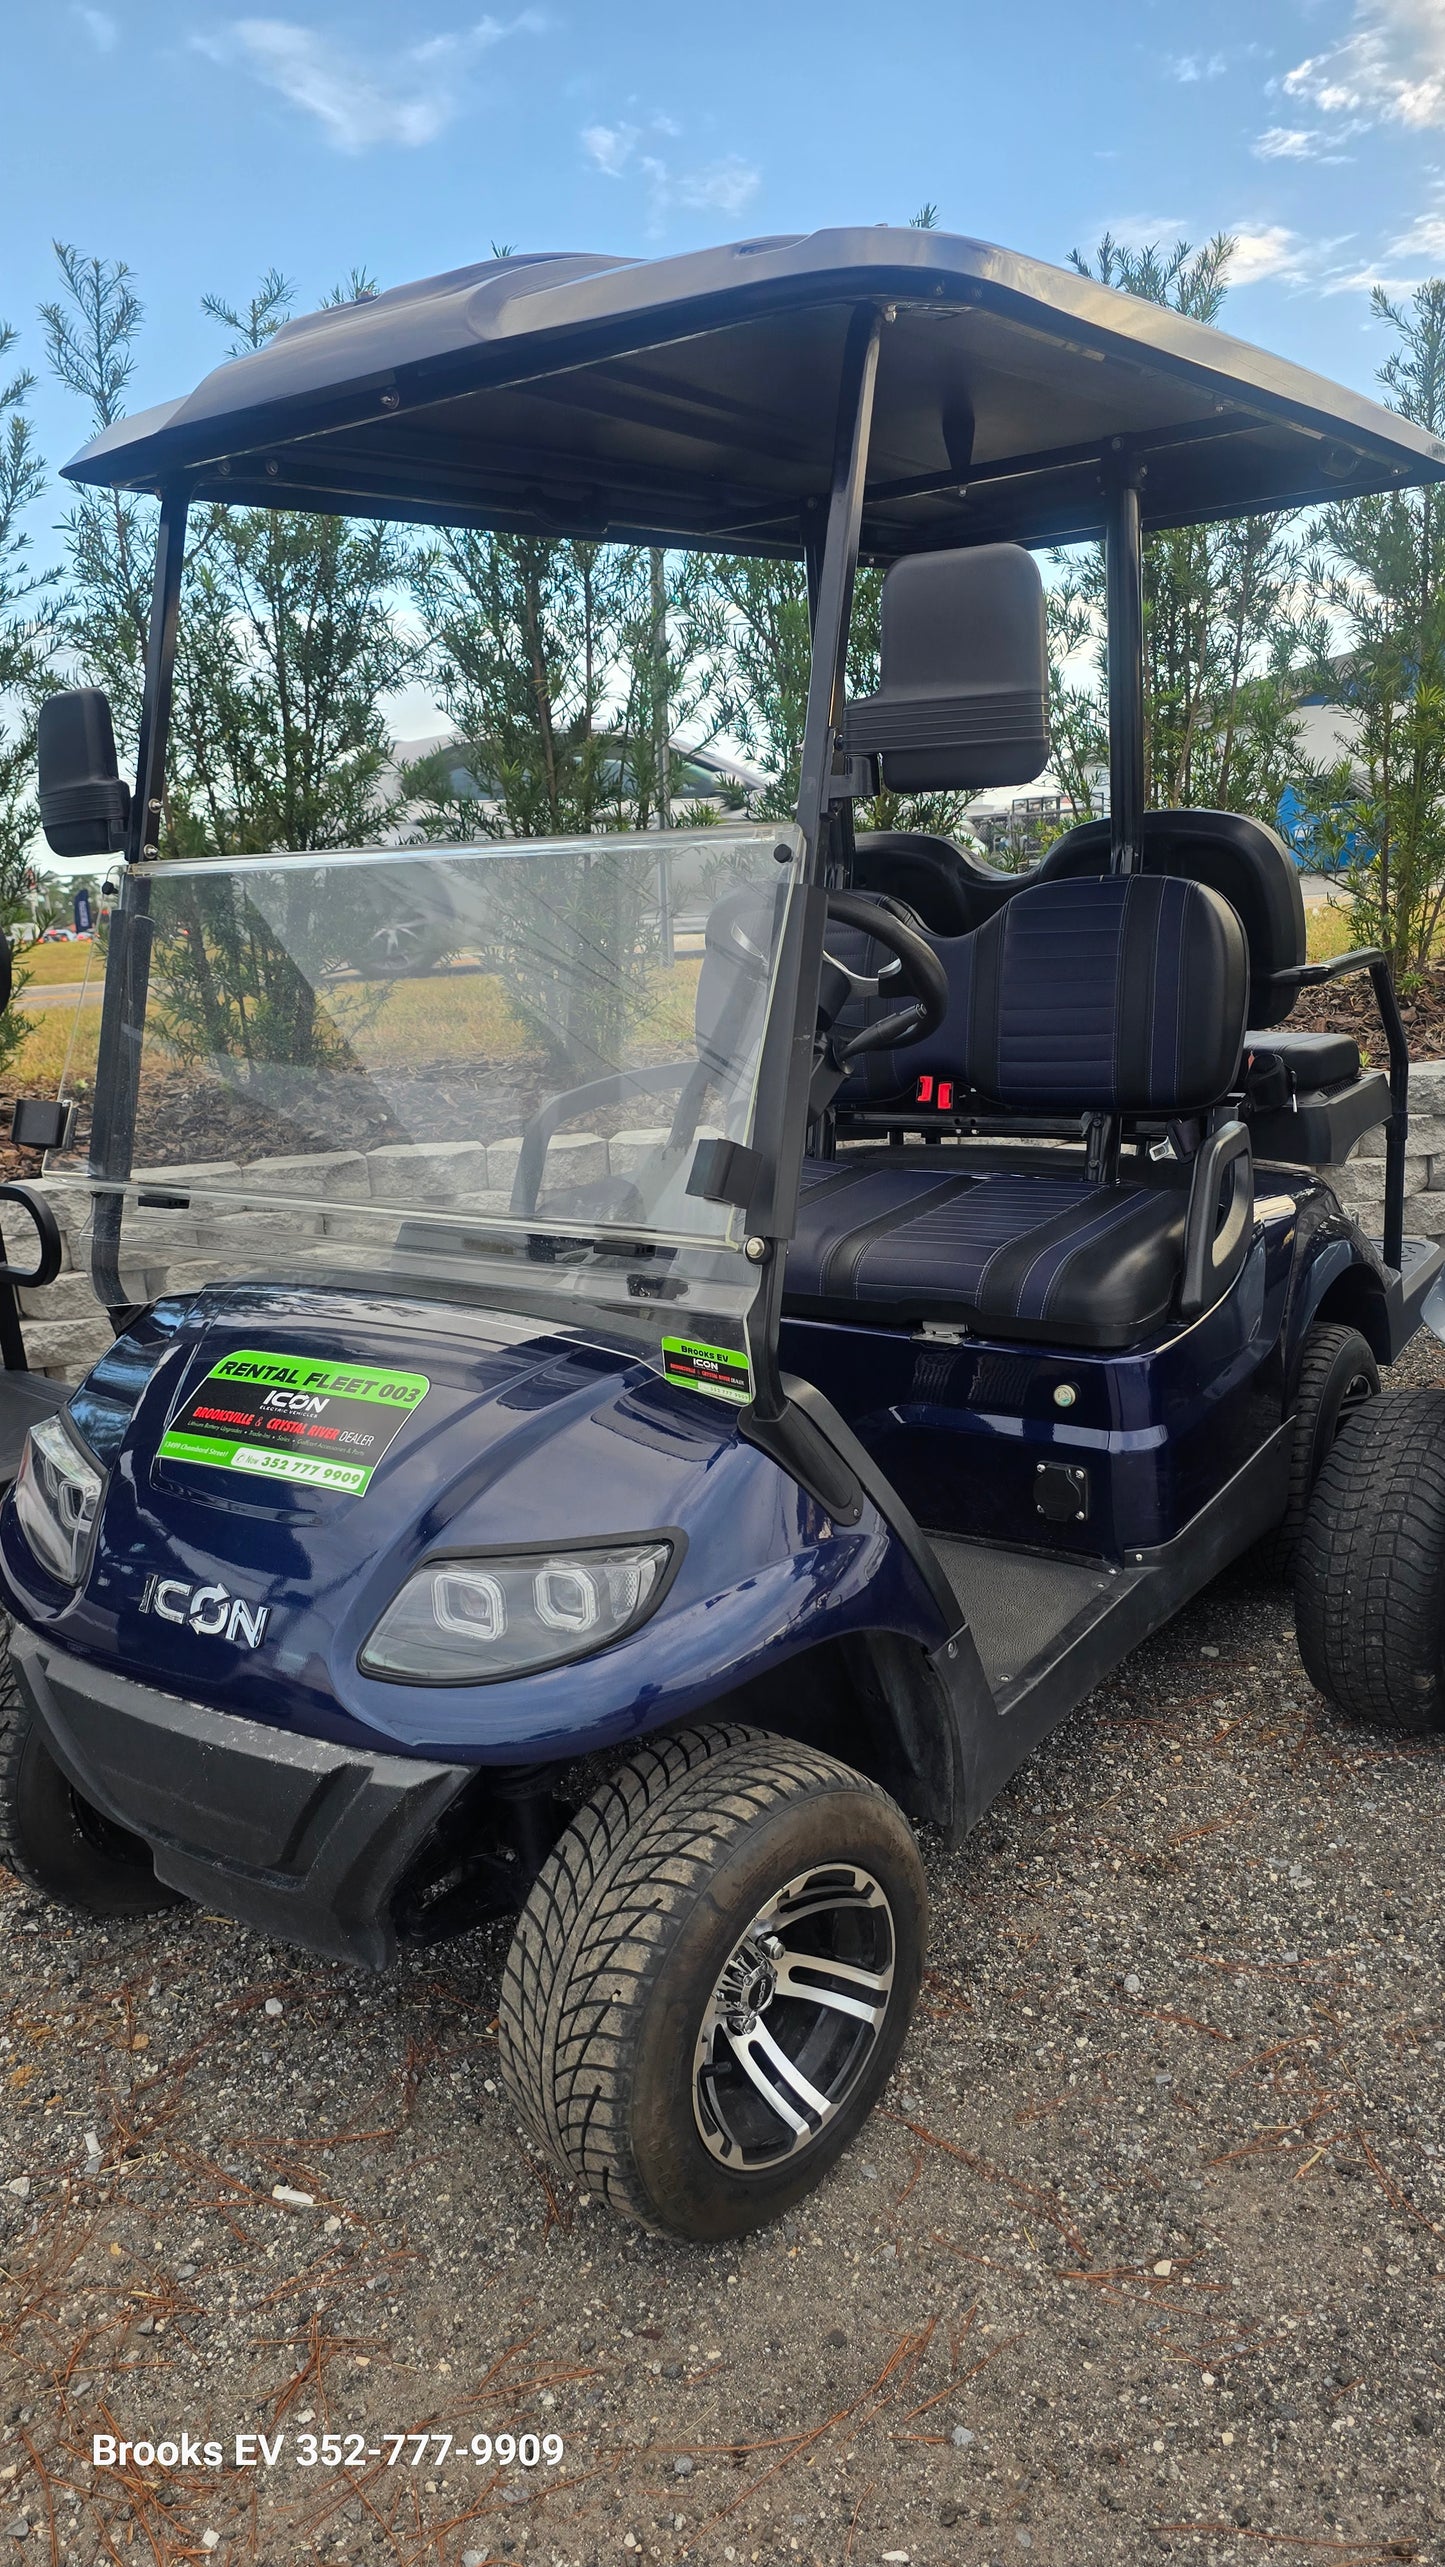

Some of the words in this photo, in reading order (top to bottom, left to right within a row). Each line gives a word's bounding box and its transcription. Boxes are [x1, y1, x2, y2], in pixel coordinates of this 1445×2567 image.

[681, 1345, 715, 1360] BROOKS
[717, 1353, 729, 1363] EV
[693, 1358, 719, 1371] ICON
[218, 1361, 300, 1385] RENTAL
[303, 1372, 379, 1395] FLEET
[378, 1383, 422, 1403] 003
[259, 1405, 288, 1414] ELECTRIC
[289, 1410, 318, 1419] VEHICLES
[263, 1390, 331, 1413] ICON
[192, 1406, 256, 1426] BROOKSVILLE
[254, 1416, 264, 1428] &
[266, 1417, 308, 1436] CRYSTAL
[307, 1424, 341, 1441] RIVER
[339, 1430, 375, 1447] DEALER
[261, 1456, 290, 1470] 352
[291, 1462, 321, 1475] 777
[323, 1468, 361, 1484] 9909
[138, 1572, 271, 1648] ICON
